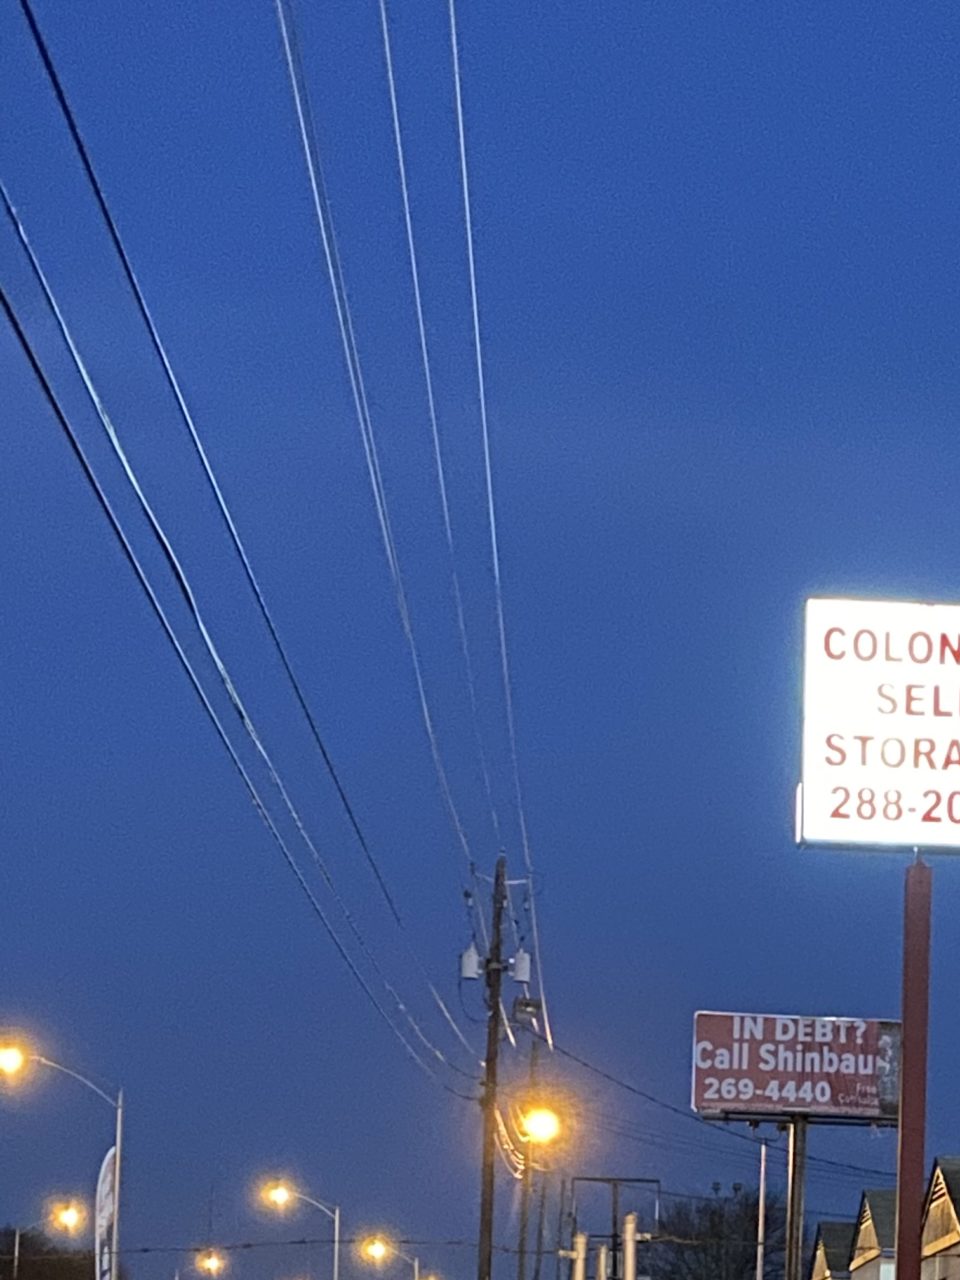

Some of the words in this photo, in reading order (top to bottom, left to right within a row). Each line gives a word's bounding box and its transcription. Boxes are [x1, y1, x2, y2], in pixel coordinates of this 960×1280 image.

[732, 1016, 763, 1039] IN
[775, 1018, 867, 1044] DEBT?
[696, 1041, 749, 1070] Call
[758, 1043, 881, 1075] Shinbau
[703, 1078, 831, 1103] 269-4440
